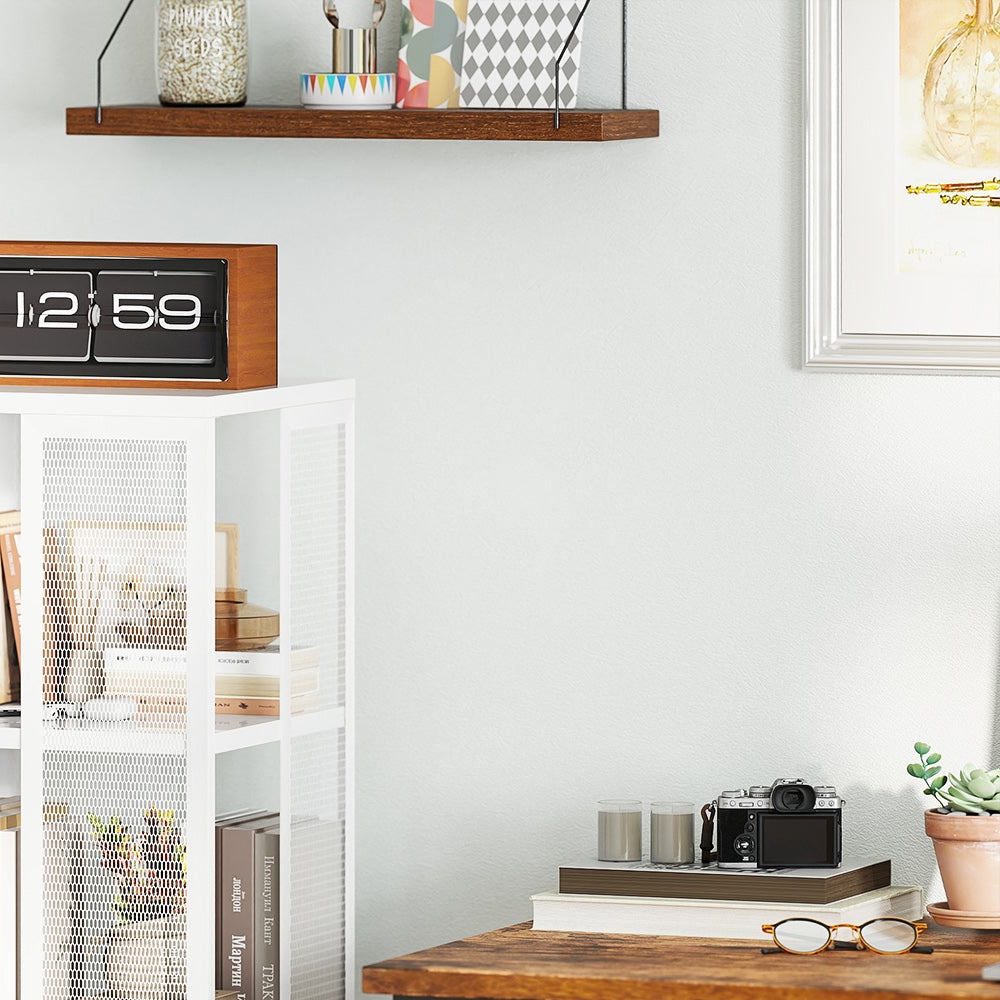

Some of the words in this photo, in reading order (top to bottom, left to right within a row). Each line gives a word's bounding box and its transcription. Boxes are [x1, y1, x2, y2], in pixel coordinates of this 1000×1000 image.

[168, 6, 233, 28] PUMPKIN
[174, 37, 223, 58] SEEDS
[16, 291, 79, 329] 12
[112, 293, 202, 330] 59
[262, 856, 275, 912] Иммануил
[263, 917, 275, 946] Кант
[229, 935, 246, 987] Мартин
